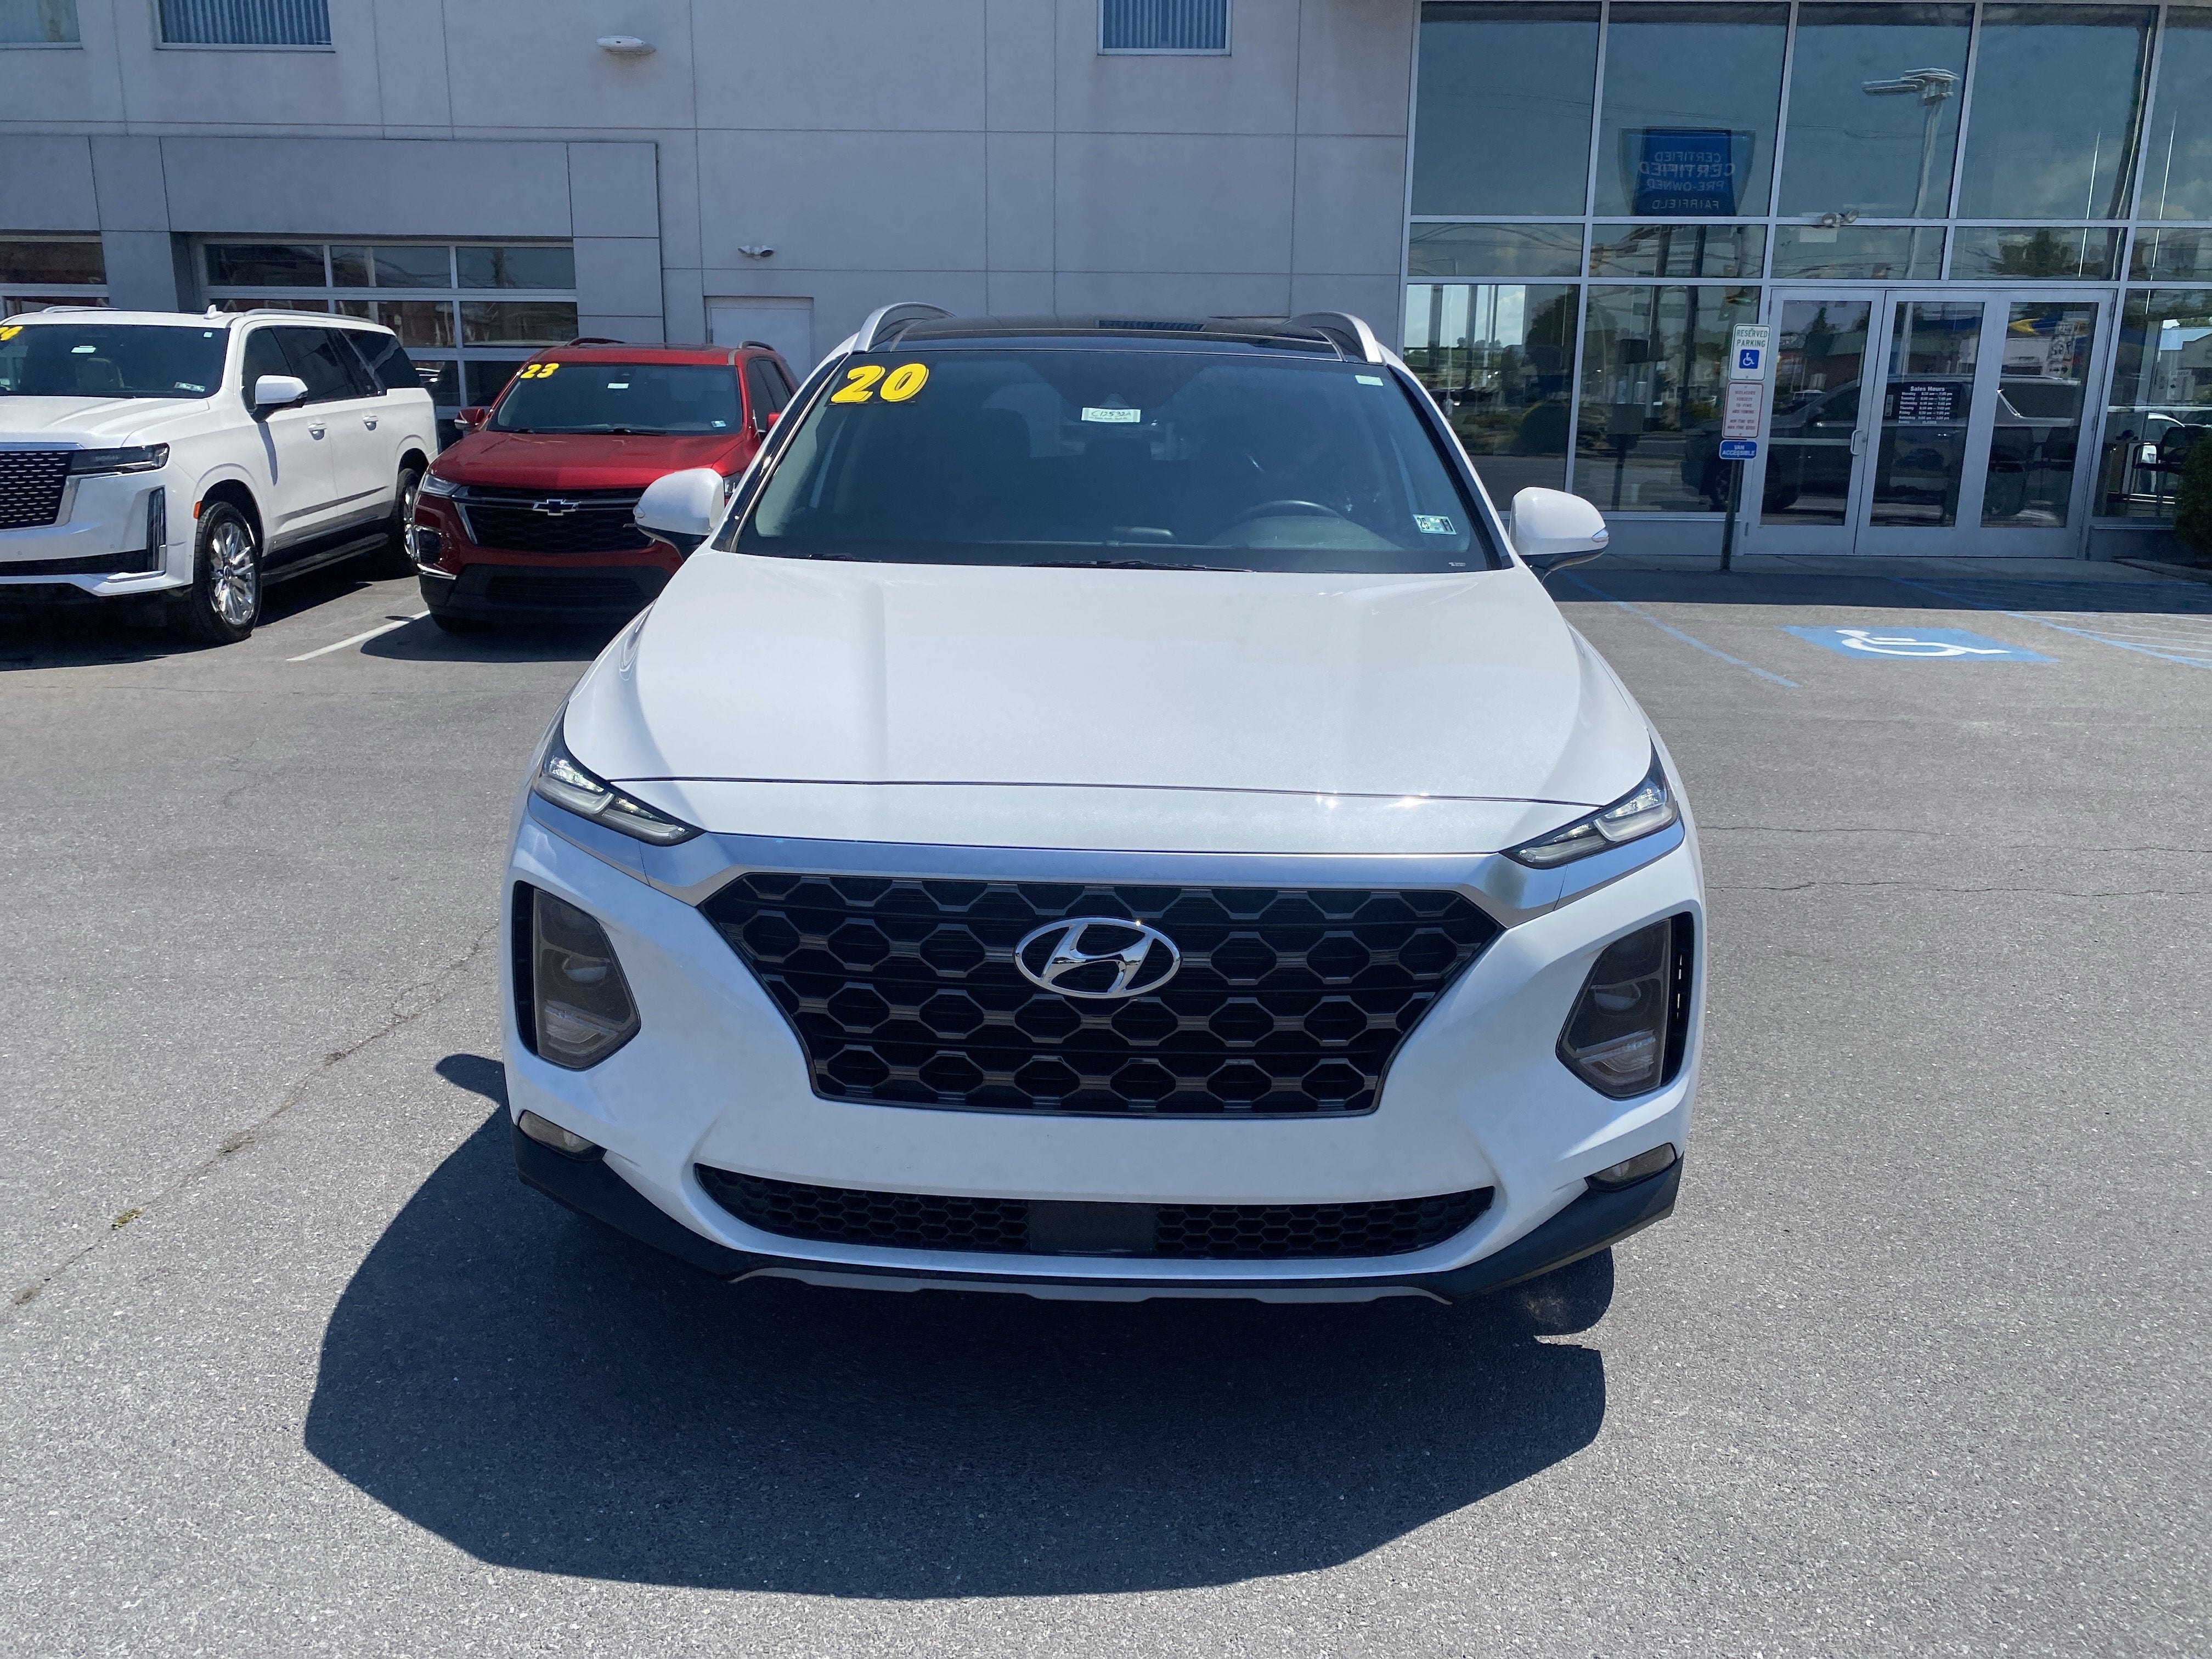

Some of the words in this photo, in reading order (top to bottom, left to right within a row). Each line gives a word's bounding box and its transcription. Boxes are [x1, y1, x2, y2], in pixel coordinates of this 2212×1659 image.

[1736, 329, 1768, 338] RESERVED
[1736, 339, 1766, 347] PARKING
[520, 363, 560, 379] 23
[831, 363, 929, 403] 20
